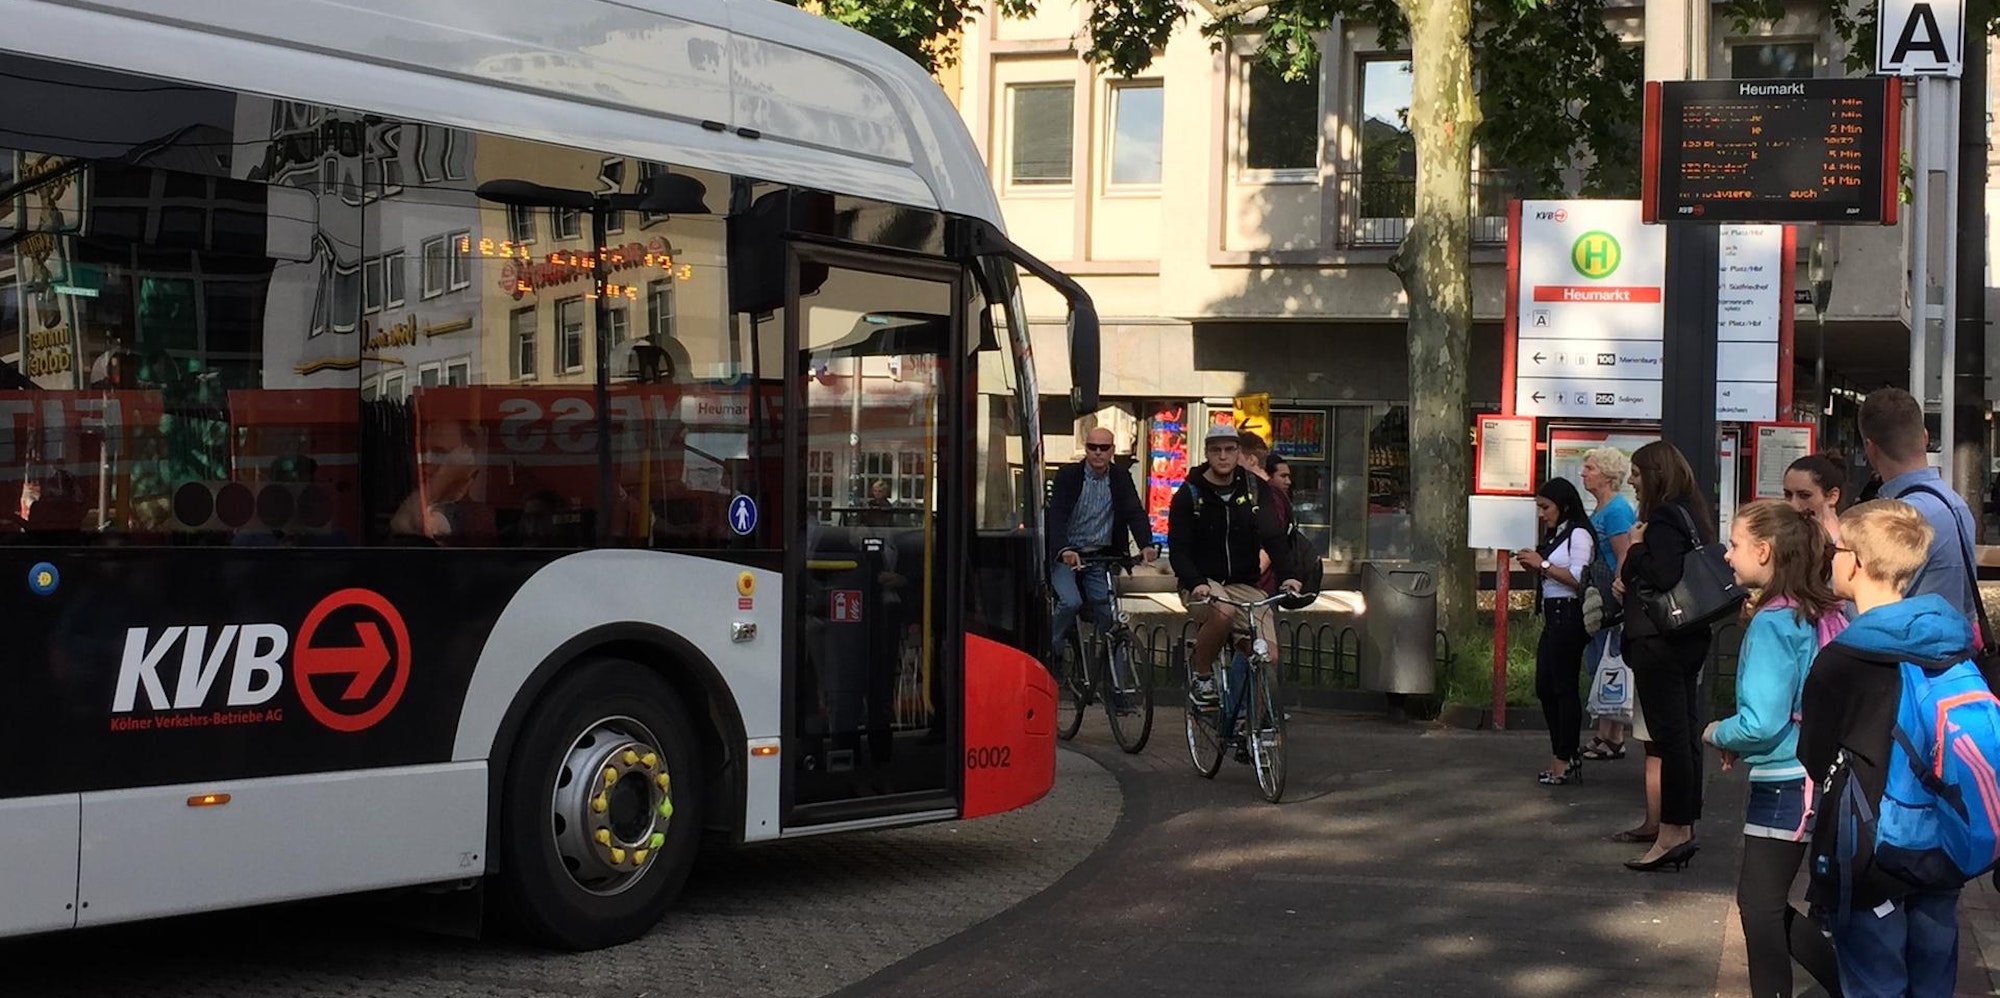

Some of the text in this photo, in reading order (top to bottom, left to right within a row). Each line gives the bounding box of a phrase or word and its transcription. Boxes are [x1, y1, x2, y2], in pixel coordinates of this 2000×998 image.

[1889, 3, 1950, 63] A
[1739, 83, 1805, 96] Heumarkt
[1829, 124, 1863, 134] 2 Min
[1840, 149, 1861, 158] Min
[1840, 163, 1861, 172] Min
[1822, 176, 1862, 186] 14 Min
[1536, 211, 1555, 221] KVB
[1584, 240, 1608, 270] H
[1563, 288, 1631, 301] Heumarkt
[1536, 315, 1546, 326] A
[1595, 394, 1614, 404] 250
[112, 623, 288, 712] KVB
[110, 708, 283, 732] Kölner Verkehrs-Betriebe AG
[966, 747, 1011, 770] 6002
